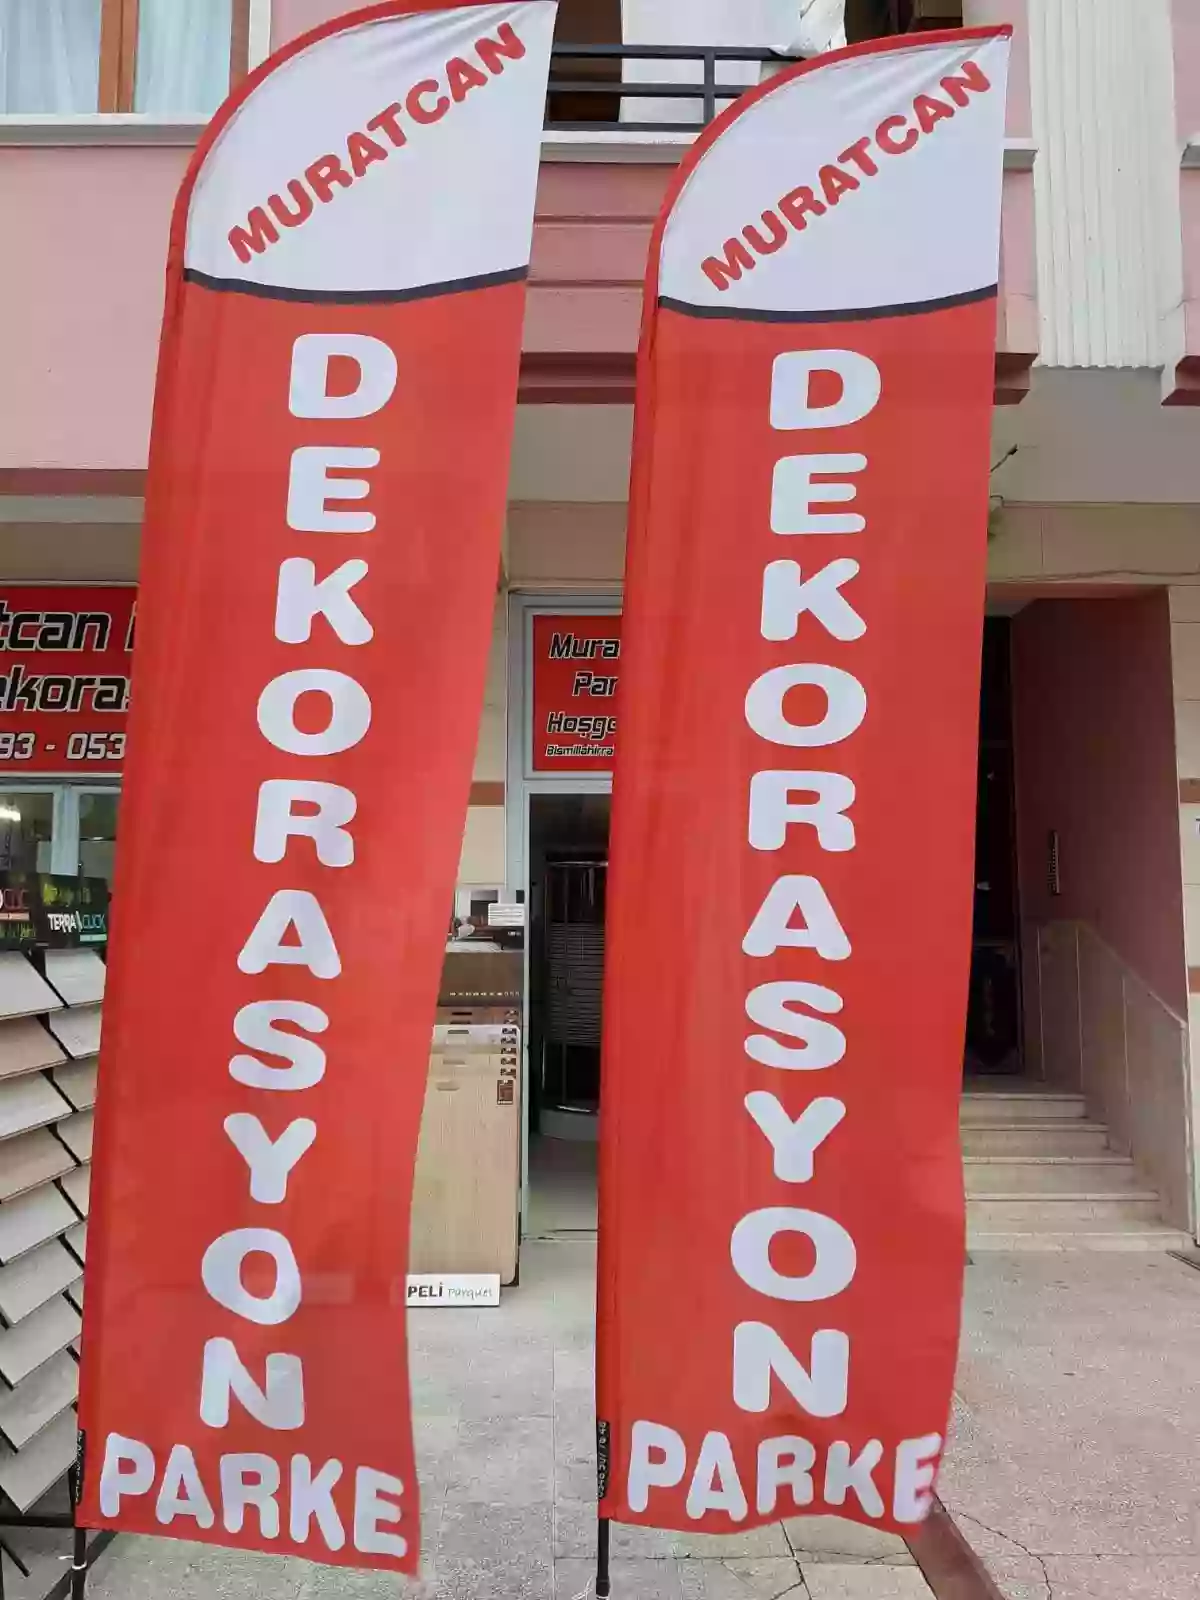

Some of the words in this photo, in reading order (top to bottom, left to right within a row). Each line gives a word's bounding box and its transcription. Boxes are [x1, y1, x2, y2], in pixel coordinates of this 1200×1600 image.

[229, 23, 525, 263] MURATCAN
[701, 61, 990, 290] MURATCAN
[549, 632, 620, 659] Mura
[572, 671, 618, 696] Par
[200, 333, 398, 1430] DEKORASYON
[730, 349, 881, 1418] DEKORASYON
[100, 1432, 408, 1558] PARKE
[627, 1419, 942, 1523] PARKE
